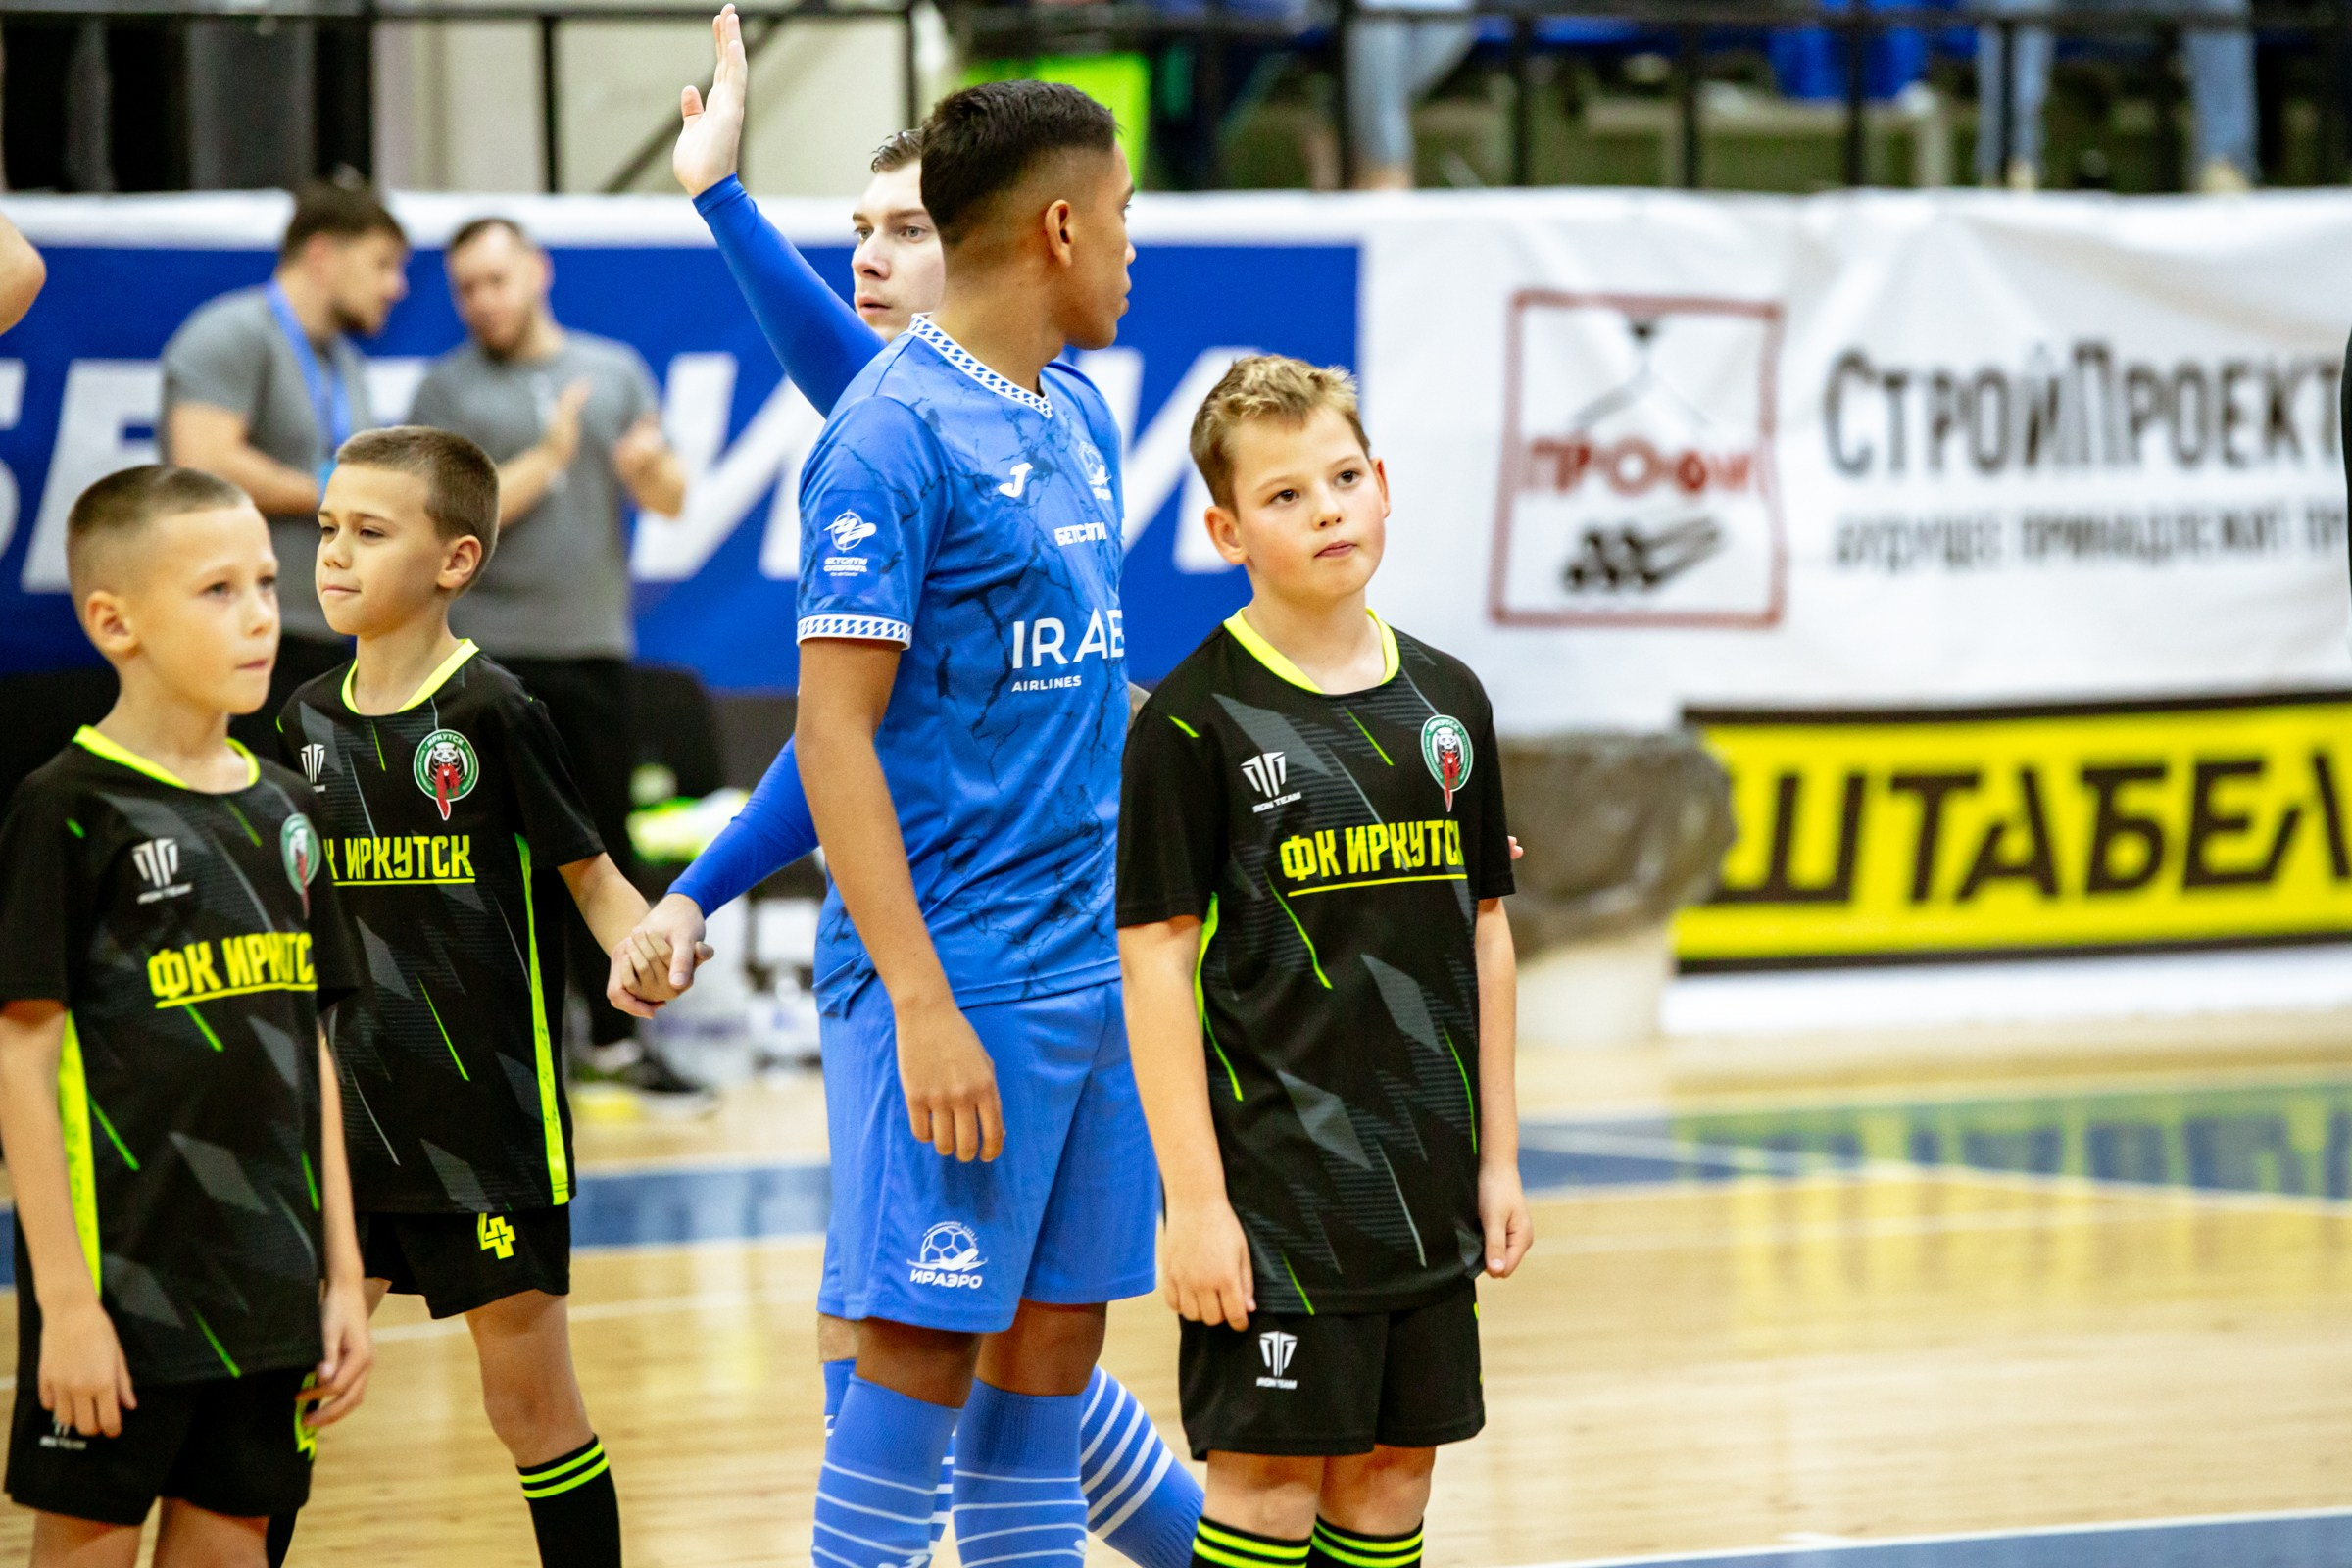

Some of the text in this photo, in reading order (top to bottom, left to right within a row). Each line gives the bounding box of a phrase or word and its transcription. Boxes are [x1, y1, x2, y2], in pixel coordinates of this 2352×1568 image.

[1054, 521, 1107, 547] БЕТСИТИ
[1011, 675, 1083, 693] AIRLINES
[426, 732, 466, 748] ИРКУТСК
[344, 835, 476, 880] ИРКУТСК
[1280, 829, 1342, 882] ФК
[147, 941, 222, 1000] ФК
[909, 1268, 983, 1290] ИРАЭРО
